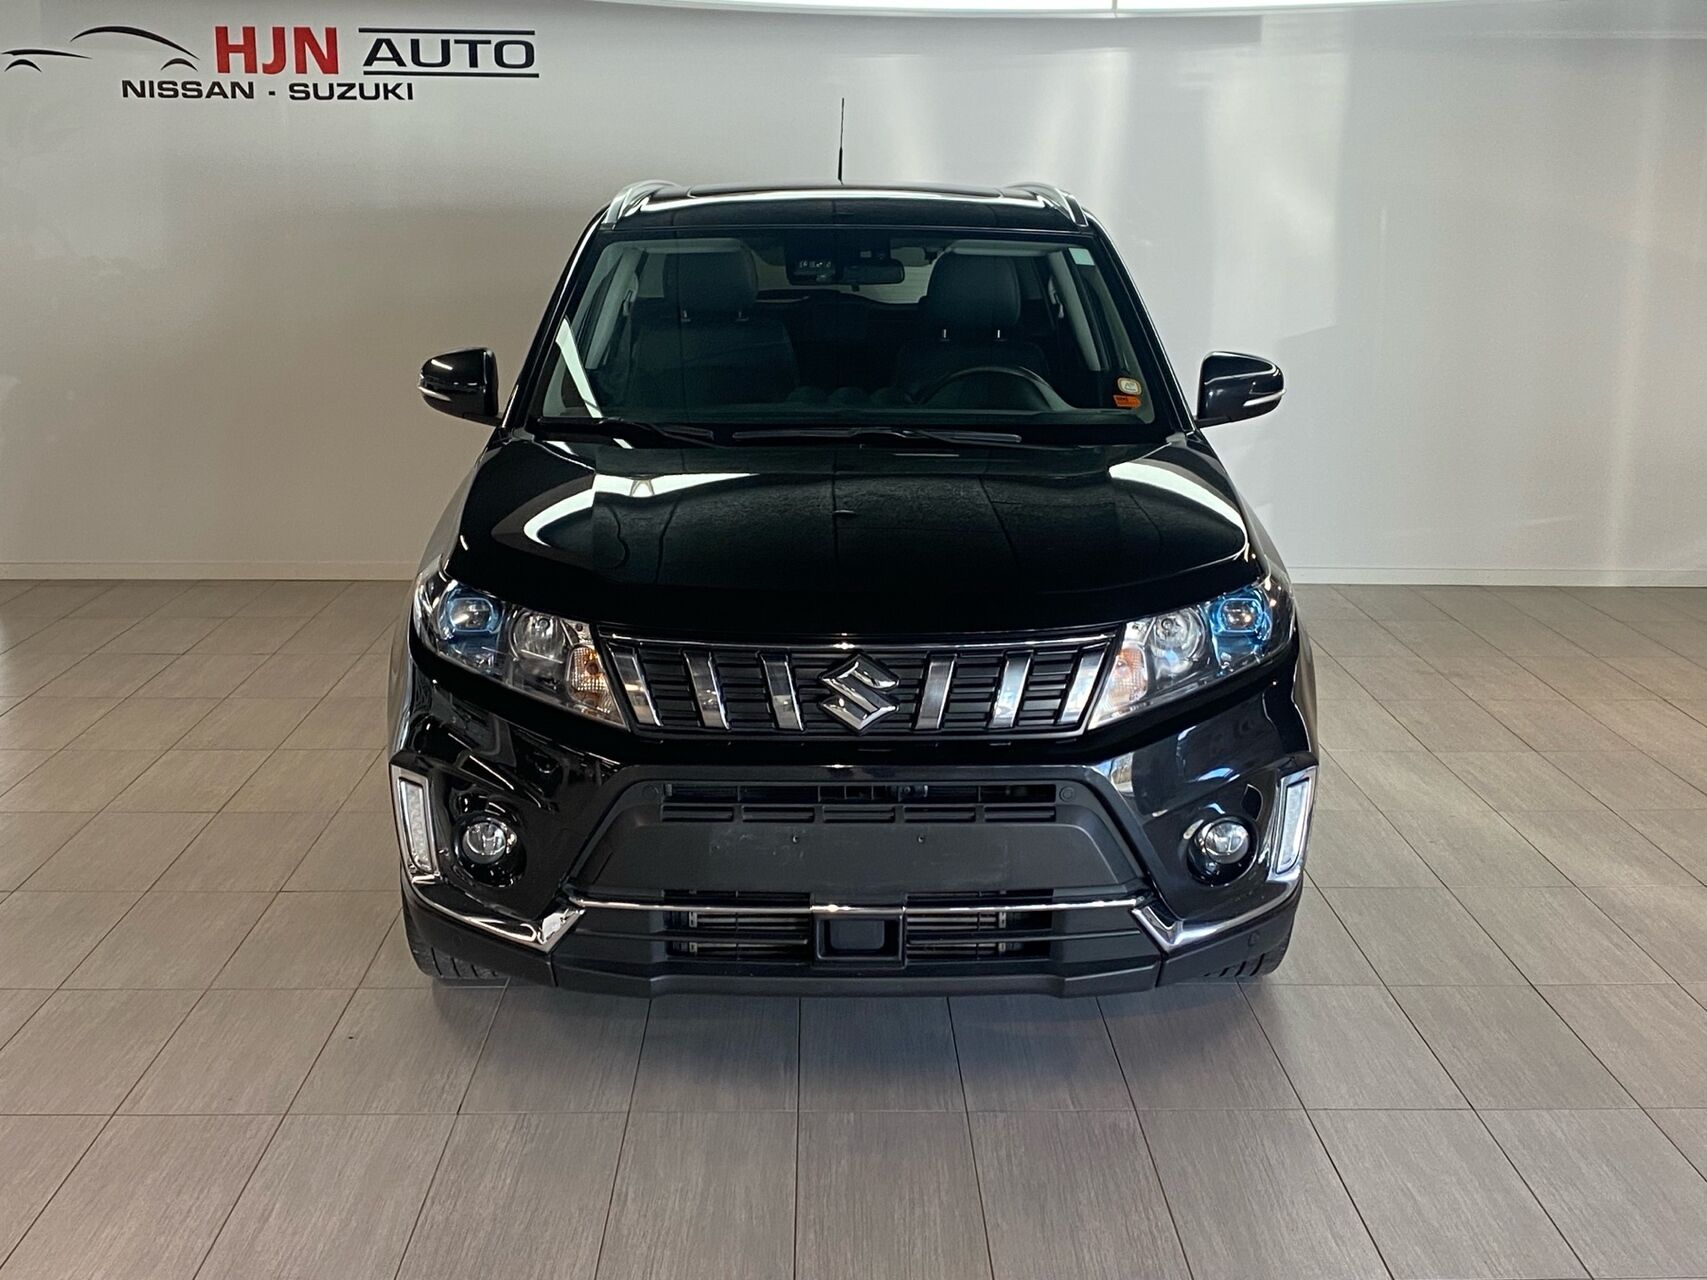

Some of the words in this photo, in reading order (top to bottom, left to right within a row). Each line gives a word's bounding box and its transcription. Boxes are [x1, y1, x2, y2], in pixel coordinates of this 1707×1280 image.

[214, 26, 339, 75] HJN
[362, 37, 535, 69] AUTO
[121, 79, 255, 100] NISSAN
[288, 82, 414, 101] SUZUKI
